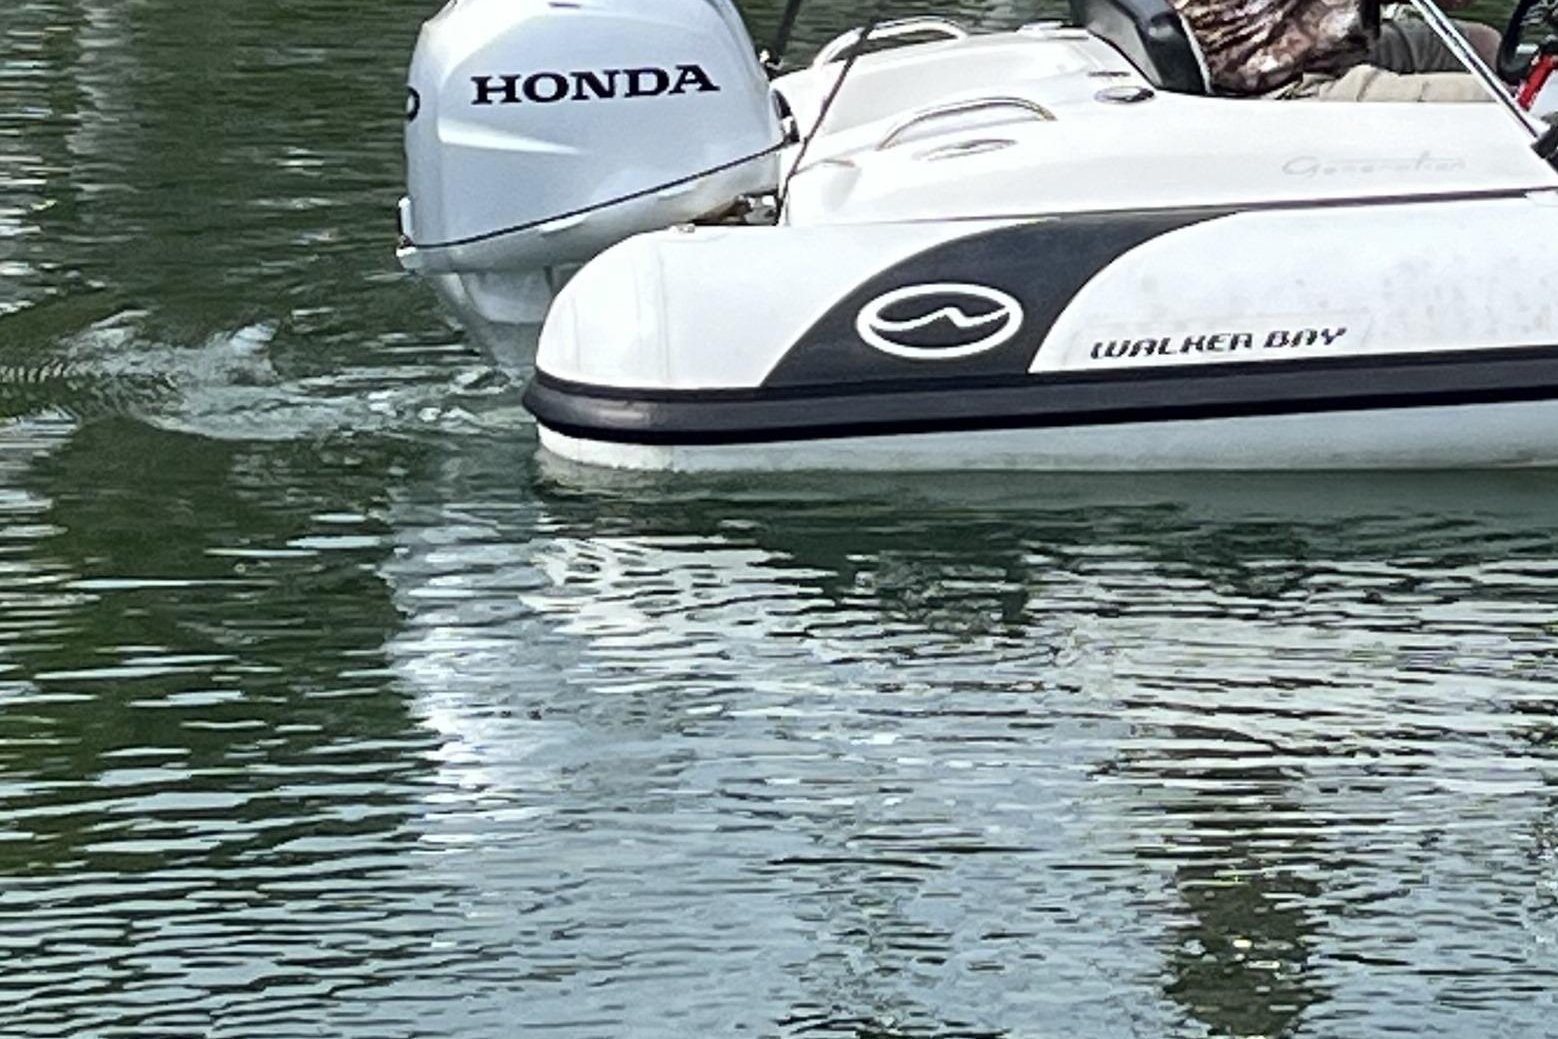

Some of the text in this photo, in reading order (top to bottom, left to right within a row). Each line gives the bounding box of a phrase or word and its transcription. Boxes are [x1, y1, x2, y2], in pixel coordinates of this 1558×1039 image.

[470, 64, 722, 105] HONDA
[1090, 327, 1348, 360] WALKER BAY
